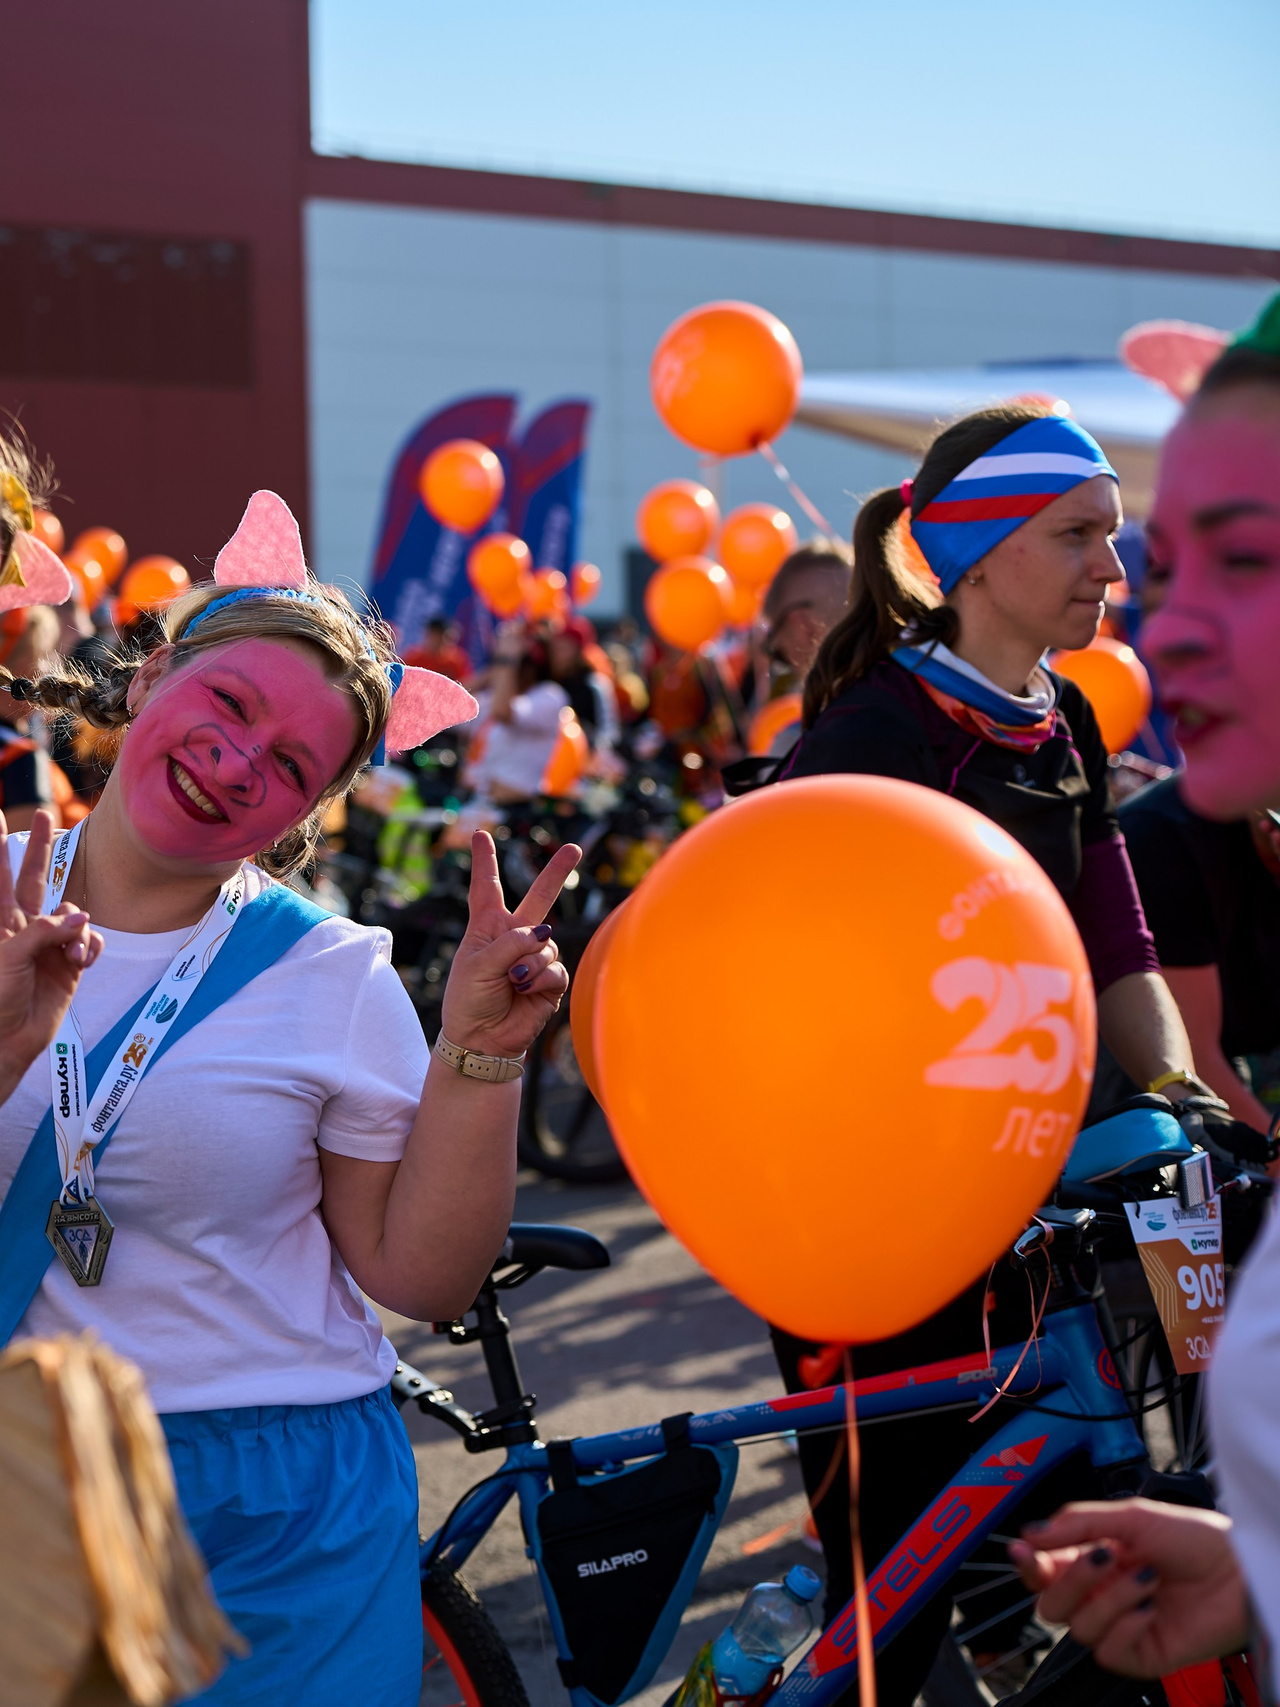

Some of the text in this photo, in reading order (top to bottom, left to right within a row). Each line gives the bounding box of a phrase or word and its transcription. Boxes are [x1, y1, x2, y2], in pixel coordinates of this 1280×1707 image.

[924, 956, 1076, 1094] 25
[57, 1057, 70, 1118] купер
[91, 1064, 139, 1133] фонтанка.ру
[123, 1042, 149, 1068] 25
[54, 1212, 100, 1223] НА ВЫСОТЕ
[577, 1548, 649, 1578] SILAPRO
[833, 1496, 971, 1656] STELS
